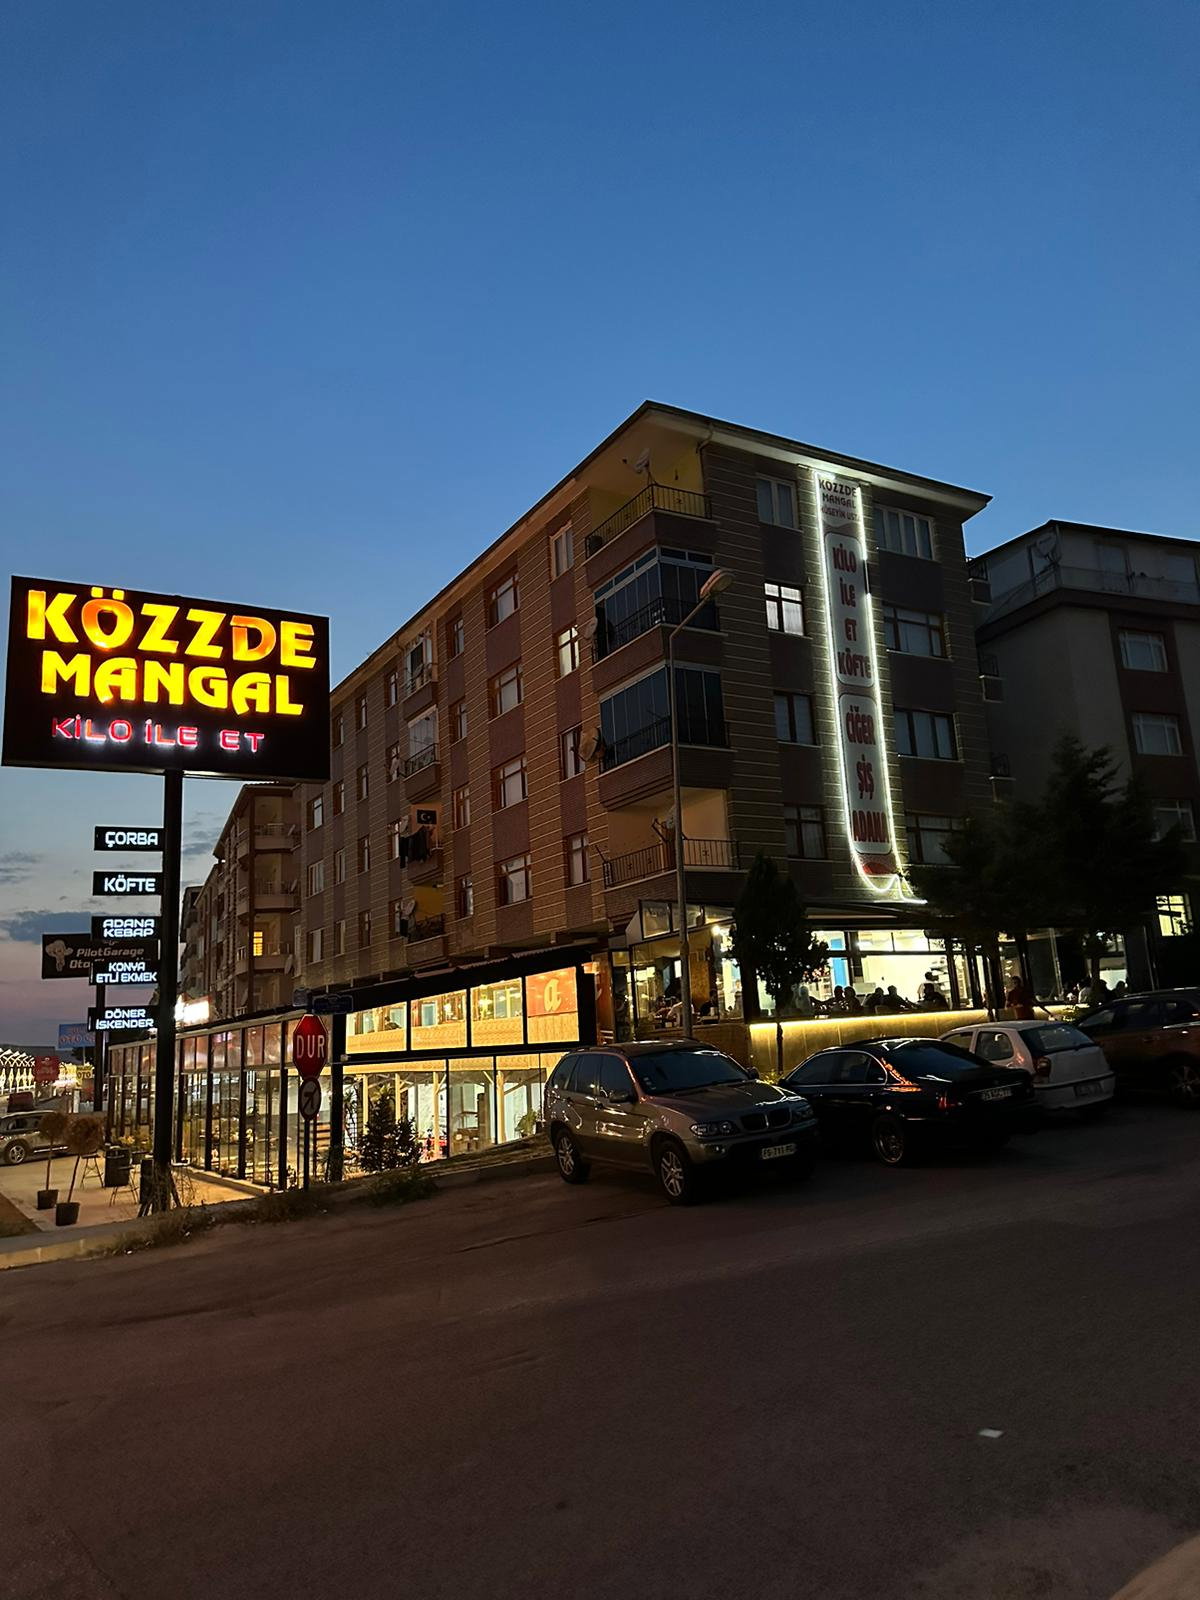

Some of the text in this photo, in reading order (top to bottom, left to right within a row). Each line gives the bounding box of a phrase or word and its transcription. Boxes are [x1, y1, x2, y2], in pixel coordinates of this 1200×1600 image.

[822, 493, 857, 509] MANGAL
[832, 543, 857, 574] KİLO
[839, 578, 856, 608] İLE
[27, 586, 317, 669] KÖZZDE
[845, 618, 857, 641] ET
[837, 648, 871, 679] KÖFTE
[41, 650, 304, 715] MANGAL
[51, 714, 265, 753] KİLO İLE ET
[856, 754, 875, 800] ŞİŞ
[852, 810, 890, 843] ADANA
[105, 831, 158, 848] ÇORBA
[104, 874, 156, 892] KÖFTE
[102, 919, 155, 928] ADANA
[103, 928, 154, 938] KEBAP
[76, 947, 145, 957] PilotGarage
[69, 959, 91, 969] Oto
[108, 961, 146, 972] KONYA
[96, 972, 158, 983] ETLİ EKMEK
[105, 1008, 146, 1019] DÖNER
[95, 1019, 154, 1030] İSKENDER
[296, 1034, 325, 1059] DUR
